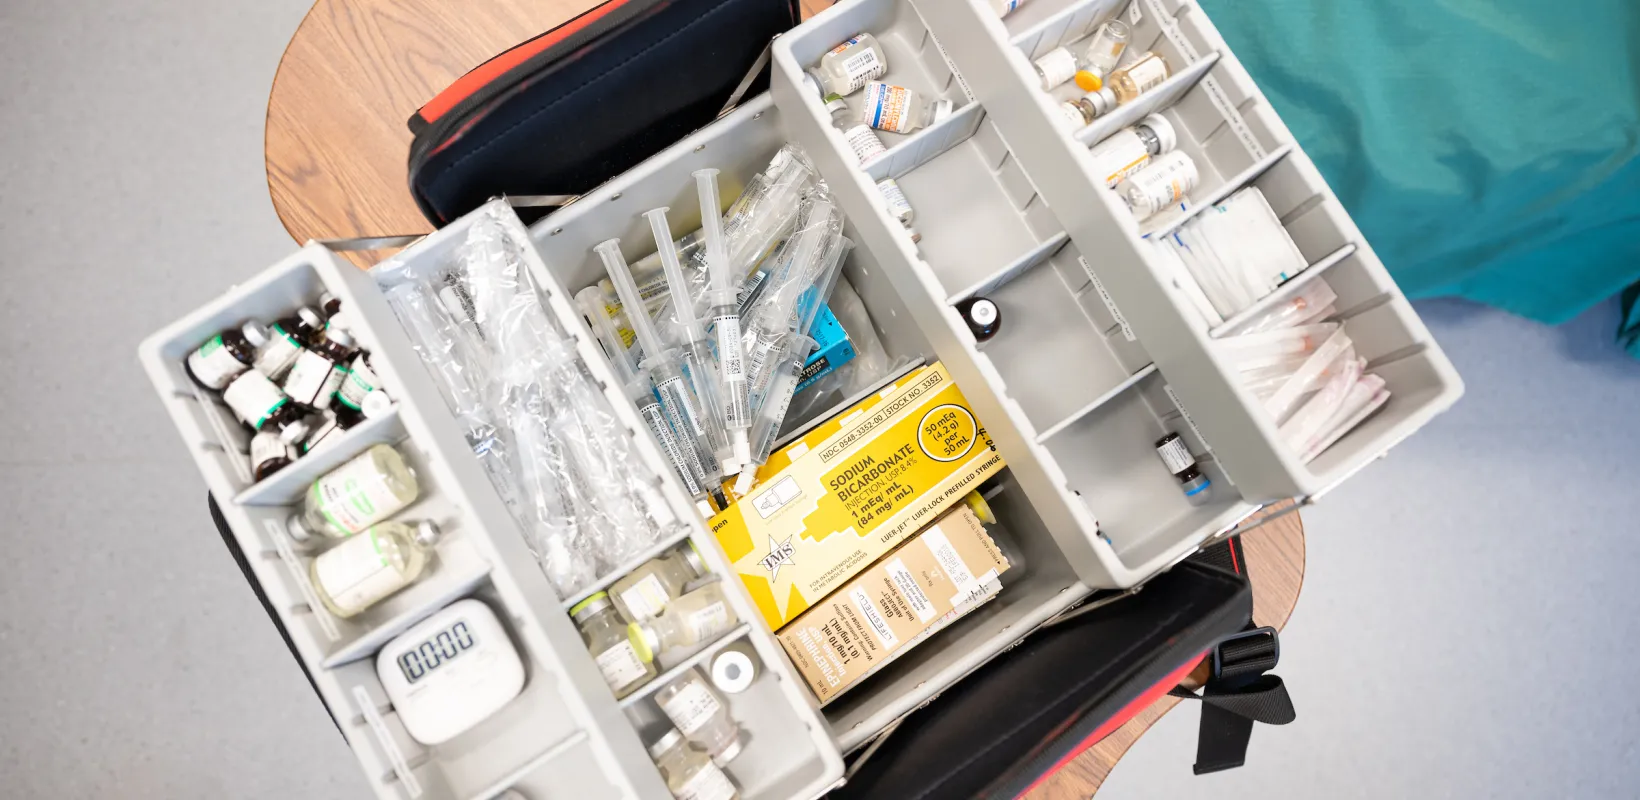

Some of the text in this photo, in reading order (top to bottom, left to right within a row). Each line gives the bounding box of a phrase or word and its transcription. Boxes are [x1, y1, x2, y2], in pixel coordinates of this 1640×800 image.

[821, 373, 940, 460] NDC 0548-3352-00 STOCK NO. 3352
[924, 409, 956, 435] 50 mEq
[931, 418, 960, 442] (4.2 g)
[942, 430, 960, 445] per
[942, 434, 970, 456] 50 mL
[828, 454, 876, 491] SODIUM
[835, 442, 916, 502] BICARBONATE
[843, 455, 917, 511] INJECTION, USP, 8.4%
[850, 479, 902, 519] 1 mEq/ mL
[910, 494, 945, 521] LUER-LOCK
[943, 472, 976, 498] PREFILLED
[967, 455, 1000, 478] SYRINGE
[855, 483, 915, 529] (84 mg/ mL)
[764, 543, 794, 568] IMS
[808, 548, 862, 588] FOR INTRAVENOUS USE
[817, 567, 846, 588] METABOLIC
[844, 551, 868, 569] ACIDOSIS
[882, 576, 898, 596] Syringe
[920, 569, 930, 581] only
[877, 598, 894, 618] Glass
[894, 594, 904, 606] Use
[904, 609, 914, 621] Unit
[820, 623, 832, 637] mL
[828, 616, 860, 659] (0.1 mg/mL)
[841, 602, 877, 651] PROTECT FROM LIGHT
[794, 626, 841, 688] EPINEPHRINE
[807, 624, 847, 676] Injection, USP
[828, 634, 848, 659] mg/10
[816, 679, 824, 688] mL
